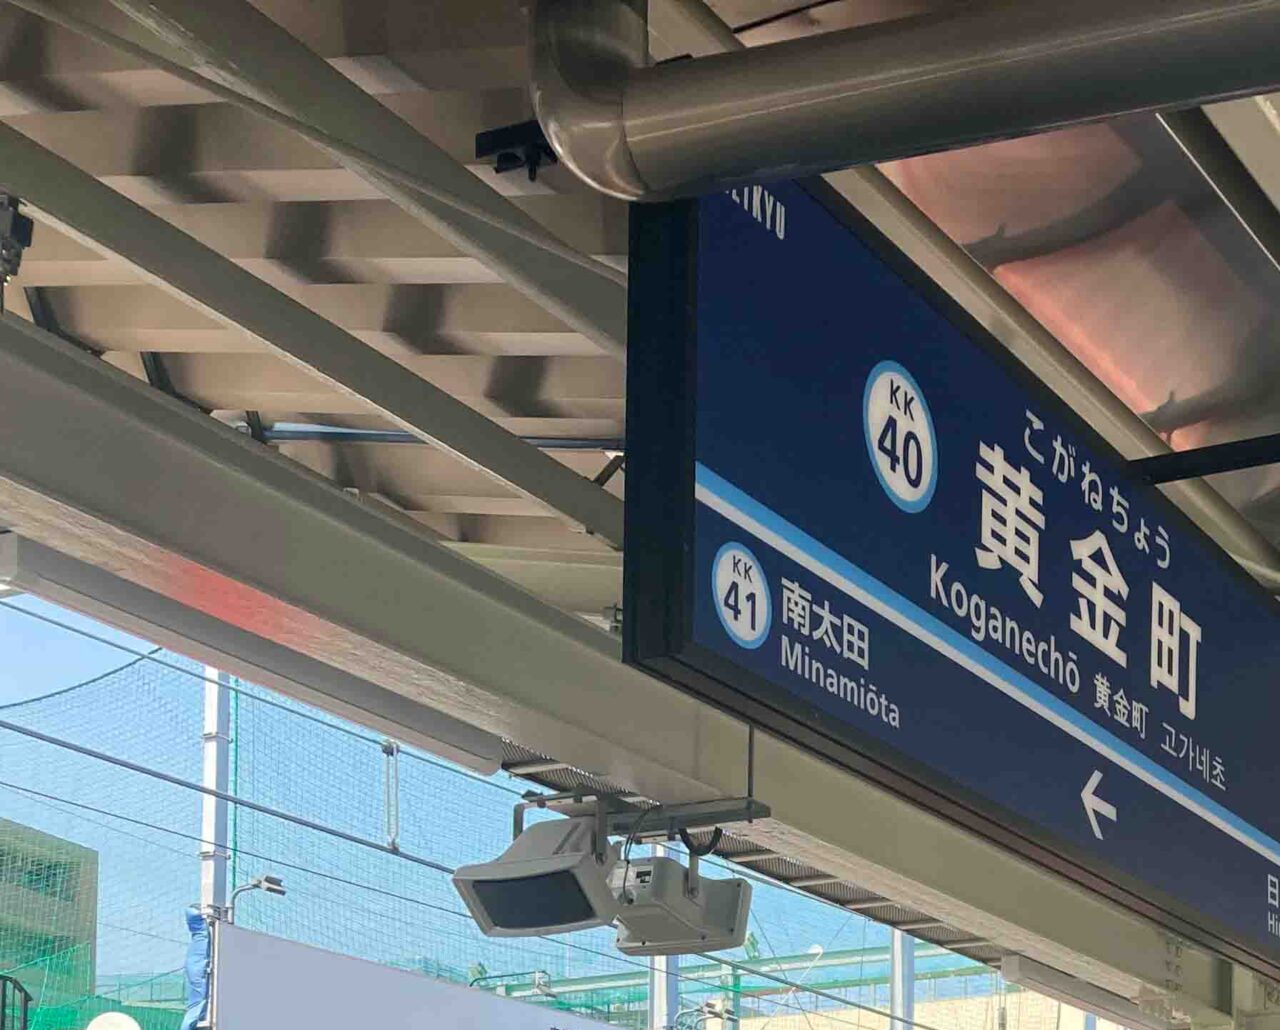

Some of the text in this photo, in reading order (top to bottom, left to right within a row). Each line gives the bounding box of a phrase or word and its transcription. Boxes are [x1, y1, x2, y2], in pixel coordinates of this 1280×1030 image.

[889, 379, 915, 421] KK
[877, 415, 923, 489] 40
[1023, 409, 1171, 569] こがねちょう
[723, 581, 757, 632] 41
[732, 555, 753, 584] KK
[975, 441, 1201, 720] 黄金町
[780, 577, 870, 671] 南太田
[780, 635, 900, 728] Minamiōta
[930, 553, 1227, 791] Koganechō 黄金町 고가네초
